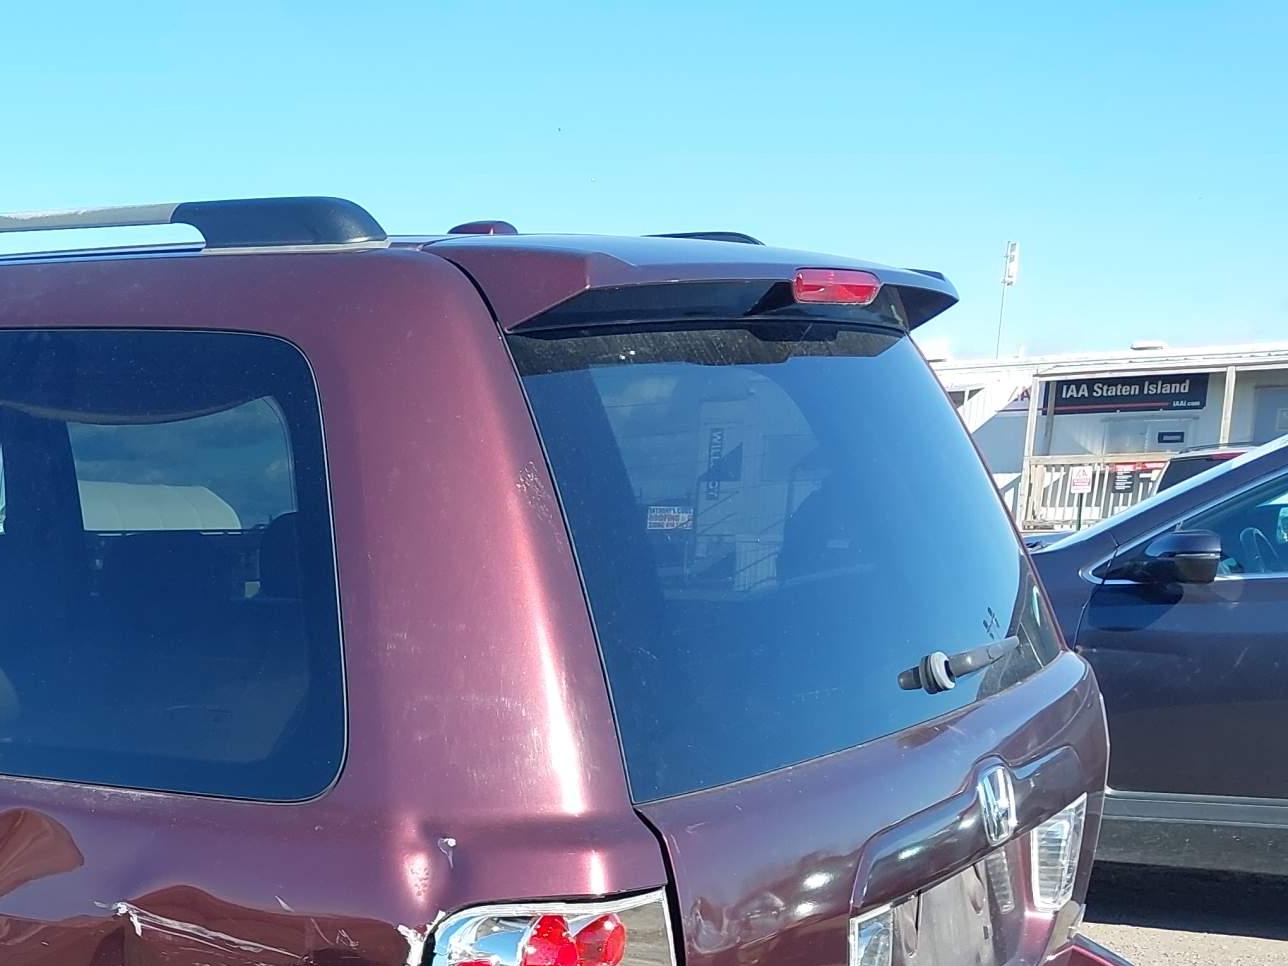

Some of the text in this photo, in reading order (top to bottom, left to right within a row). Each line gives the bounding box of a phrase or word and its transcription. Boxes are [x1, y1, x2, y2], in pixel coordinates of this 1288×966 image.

[1062, 379, 1190, 398] IAA Staten Island
